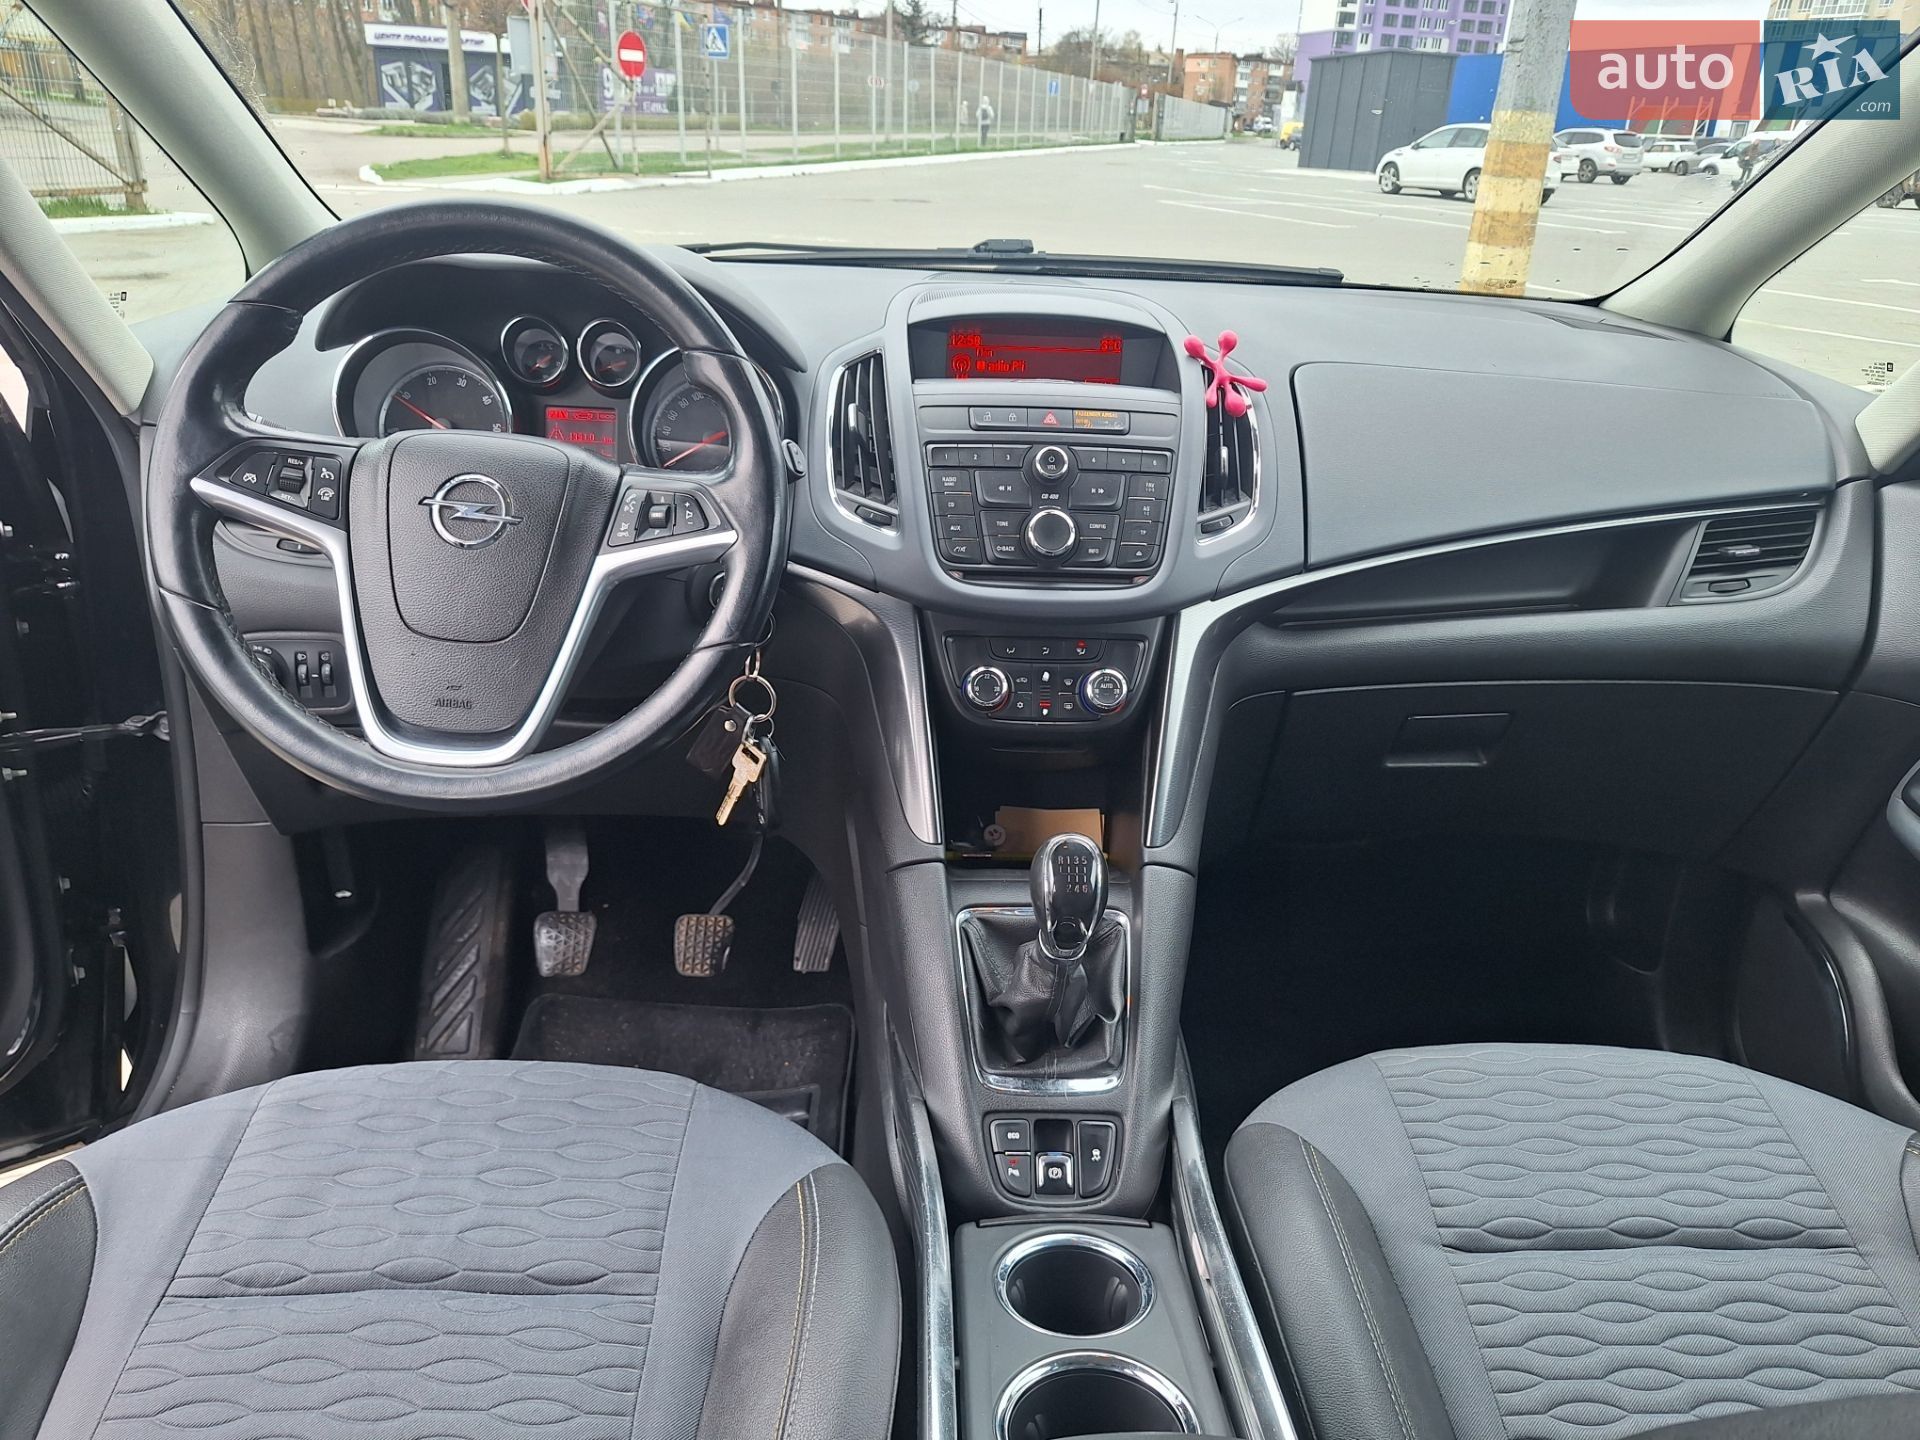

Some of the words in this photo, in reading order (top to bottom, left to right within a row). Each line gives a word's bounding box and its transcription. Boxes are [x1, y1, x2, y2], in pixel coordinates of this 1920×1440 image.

[374, 32, 401, 40] ЦЕНТР
[426, 376, 437, 386] 20
[456, 378, 467, 388] 30
[482, 396, 492, 406] 40
[678, 398, 690, 408] 80
[668, 410, 678, 420] 60
[662, 426, 672, 436] 40
[662, 442, 672, 452] 20
[434, 698, 472, 710] AIRBAG
